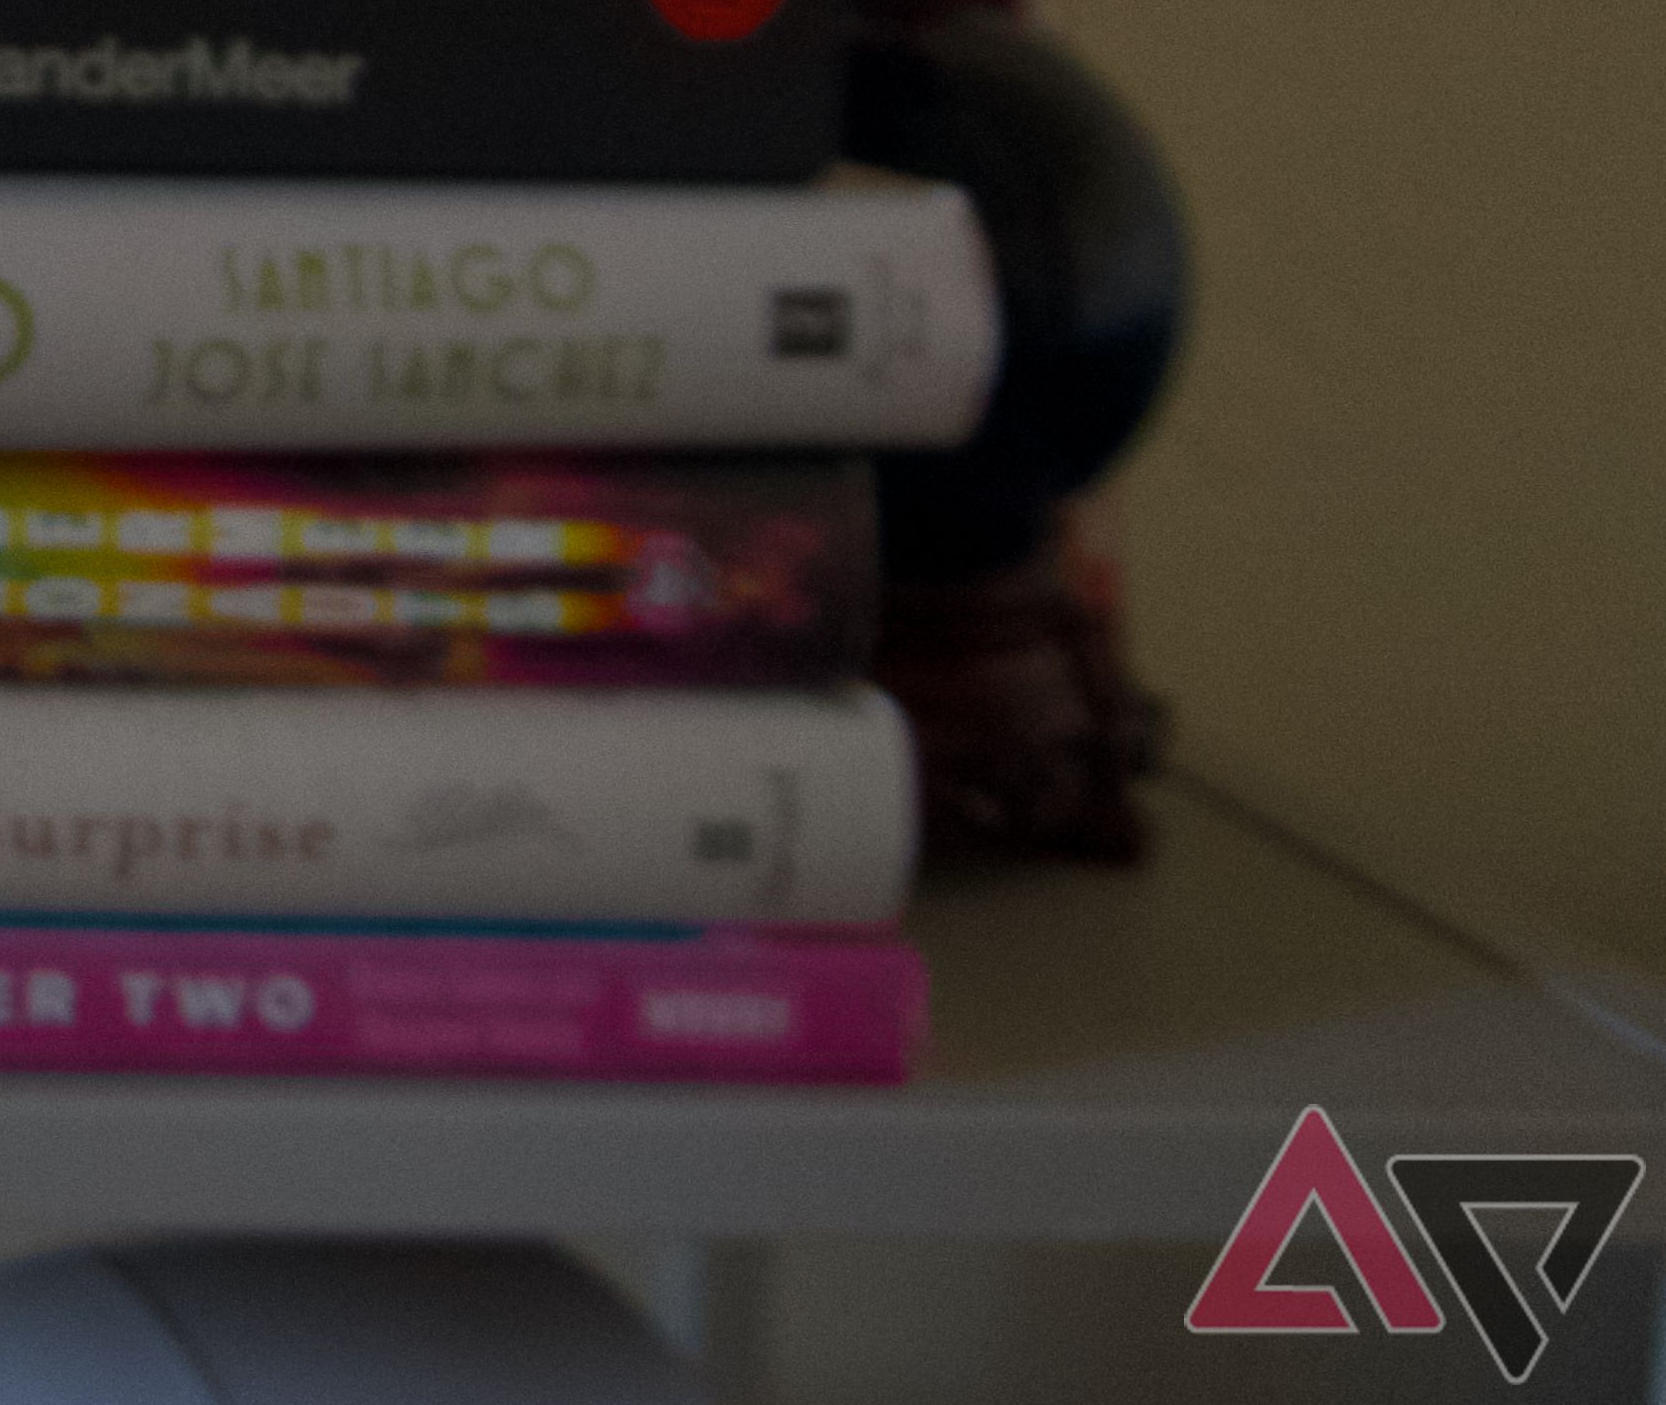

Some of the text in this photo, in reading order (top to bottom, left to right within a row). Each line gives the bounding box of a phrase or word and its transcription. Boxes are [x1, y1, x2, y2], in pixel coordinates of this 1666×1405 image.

[219, 241, 596, 316] SANTIAGO
[369, 335, 665, 408] SANCHEZ
[119, 969, 318, 1034] TWO
